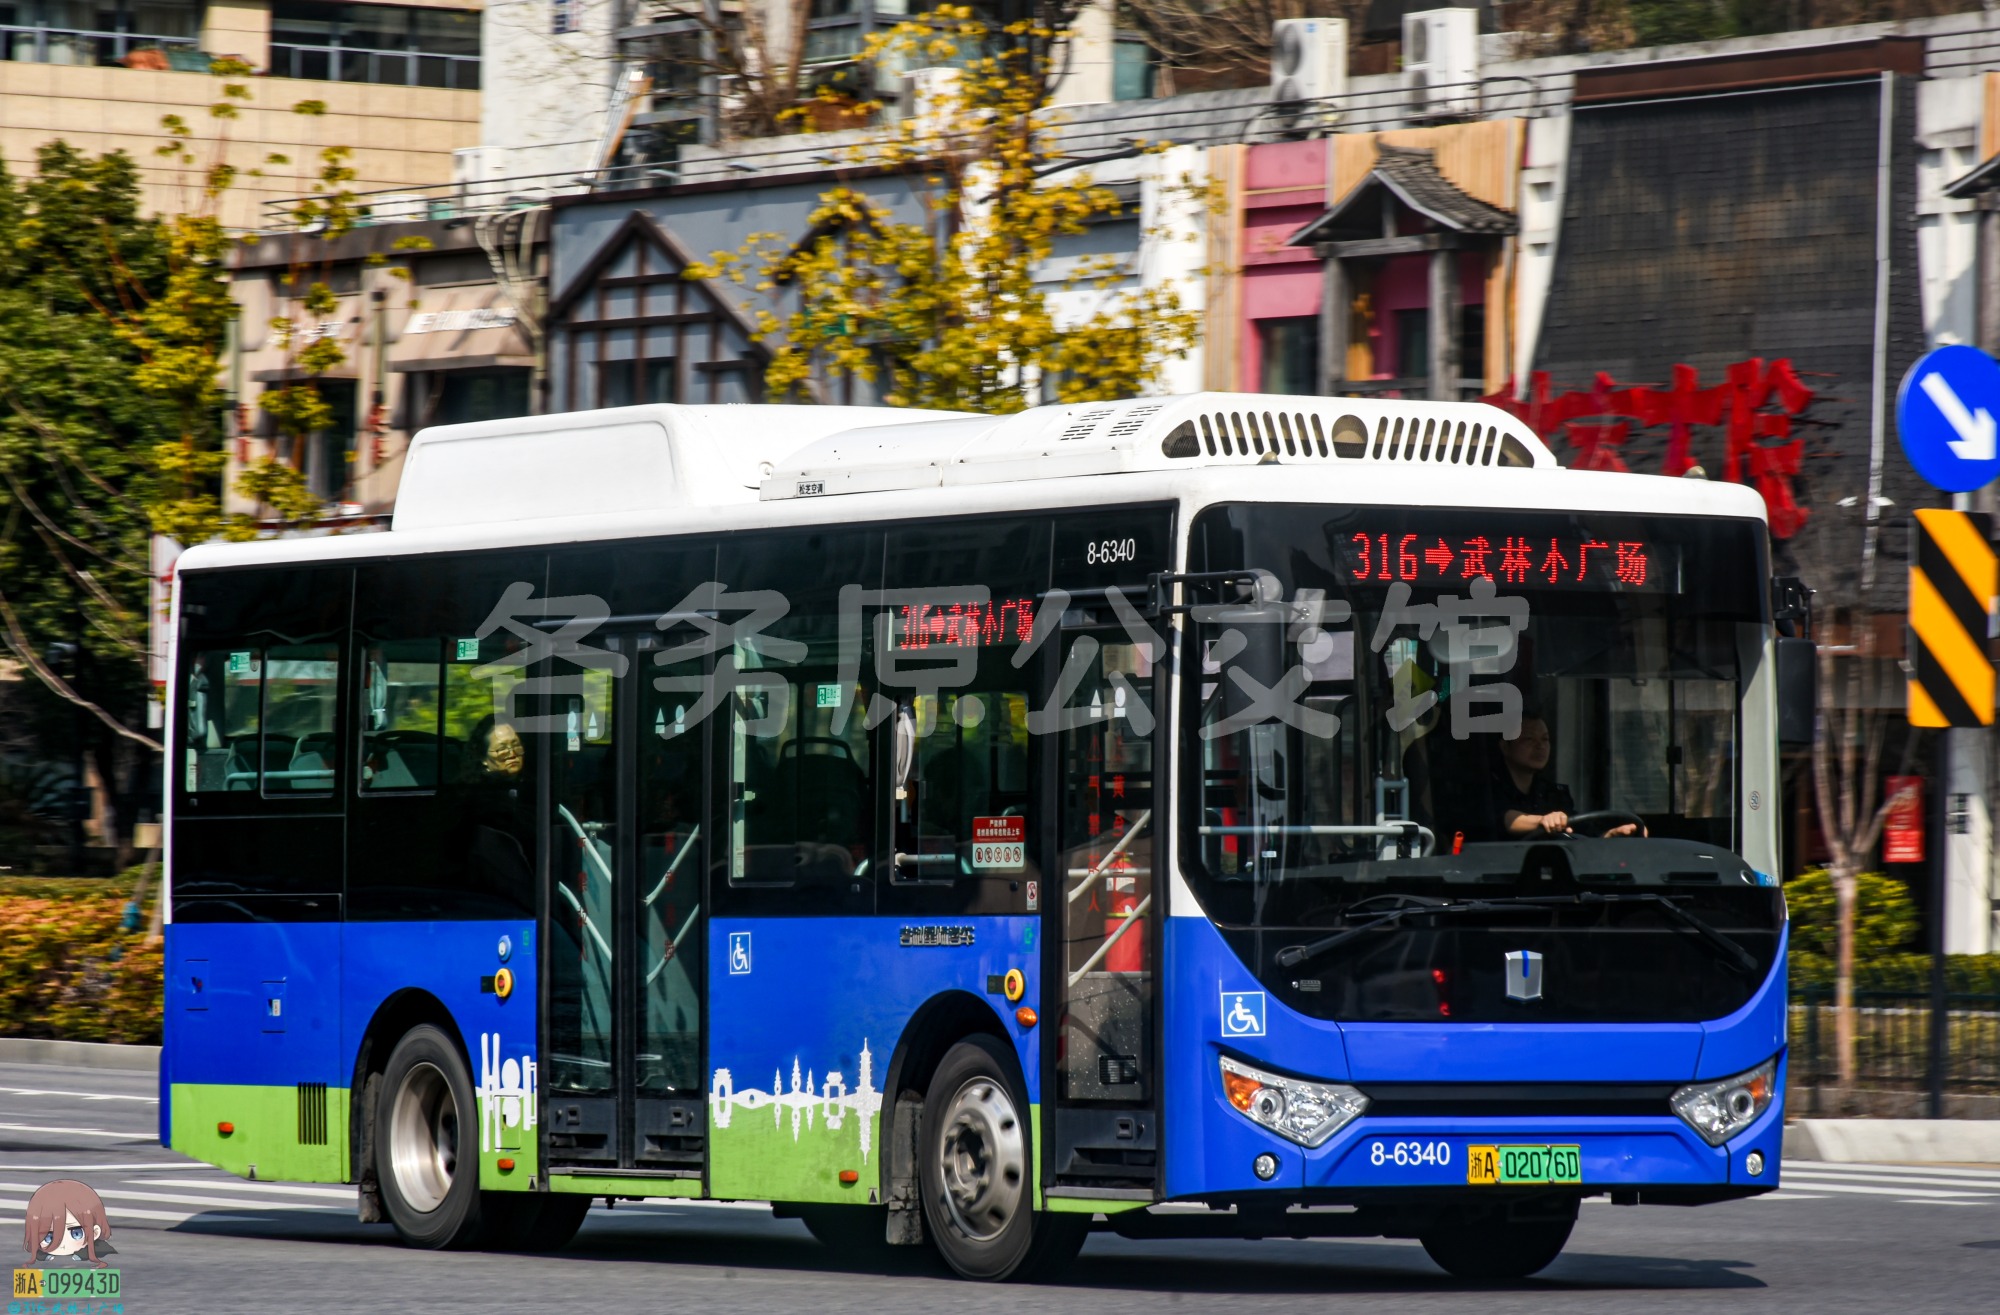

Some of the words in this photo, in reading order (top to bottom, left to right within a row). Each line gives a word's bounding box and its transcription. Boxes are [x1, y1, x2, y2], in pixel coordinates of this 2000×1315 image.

[1087, 538, 1136, 565] 8-6340
[1352, 533, 1418, 580] 316
[1460, 536, 1648, 585] 武林小广场
[901, 604, 931, 650] 316
[946, 598, 1033, 647] 武林小广场
[1371, 1142, 1451, 1166] 8-6340
